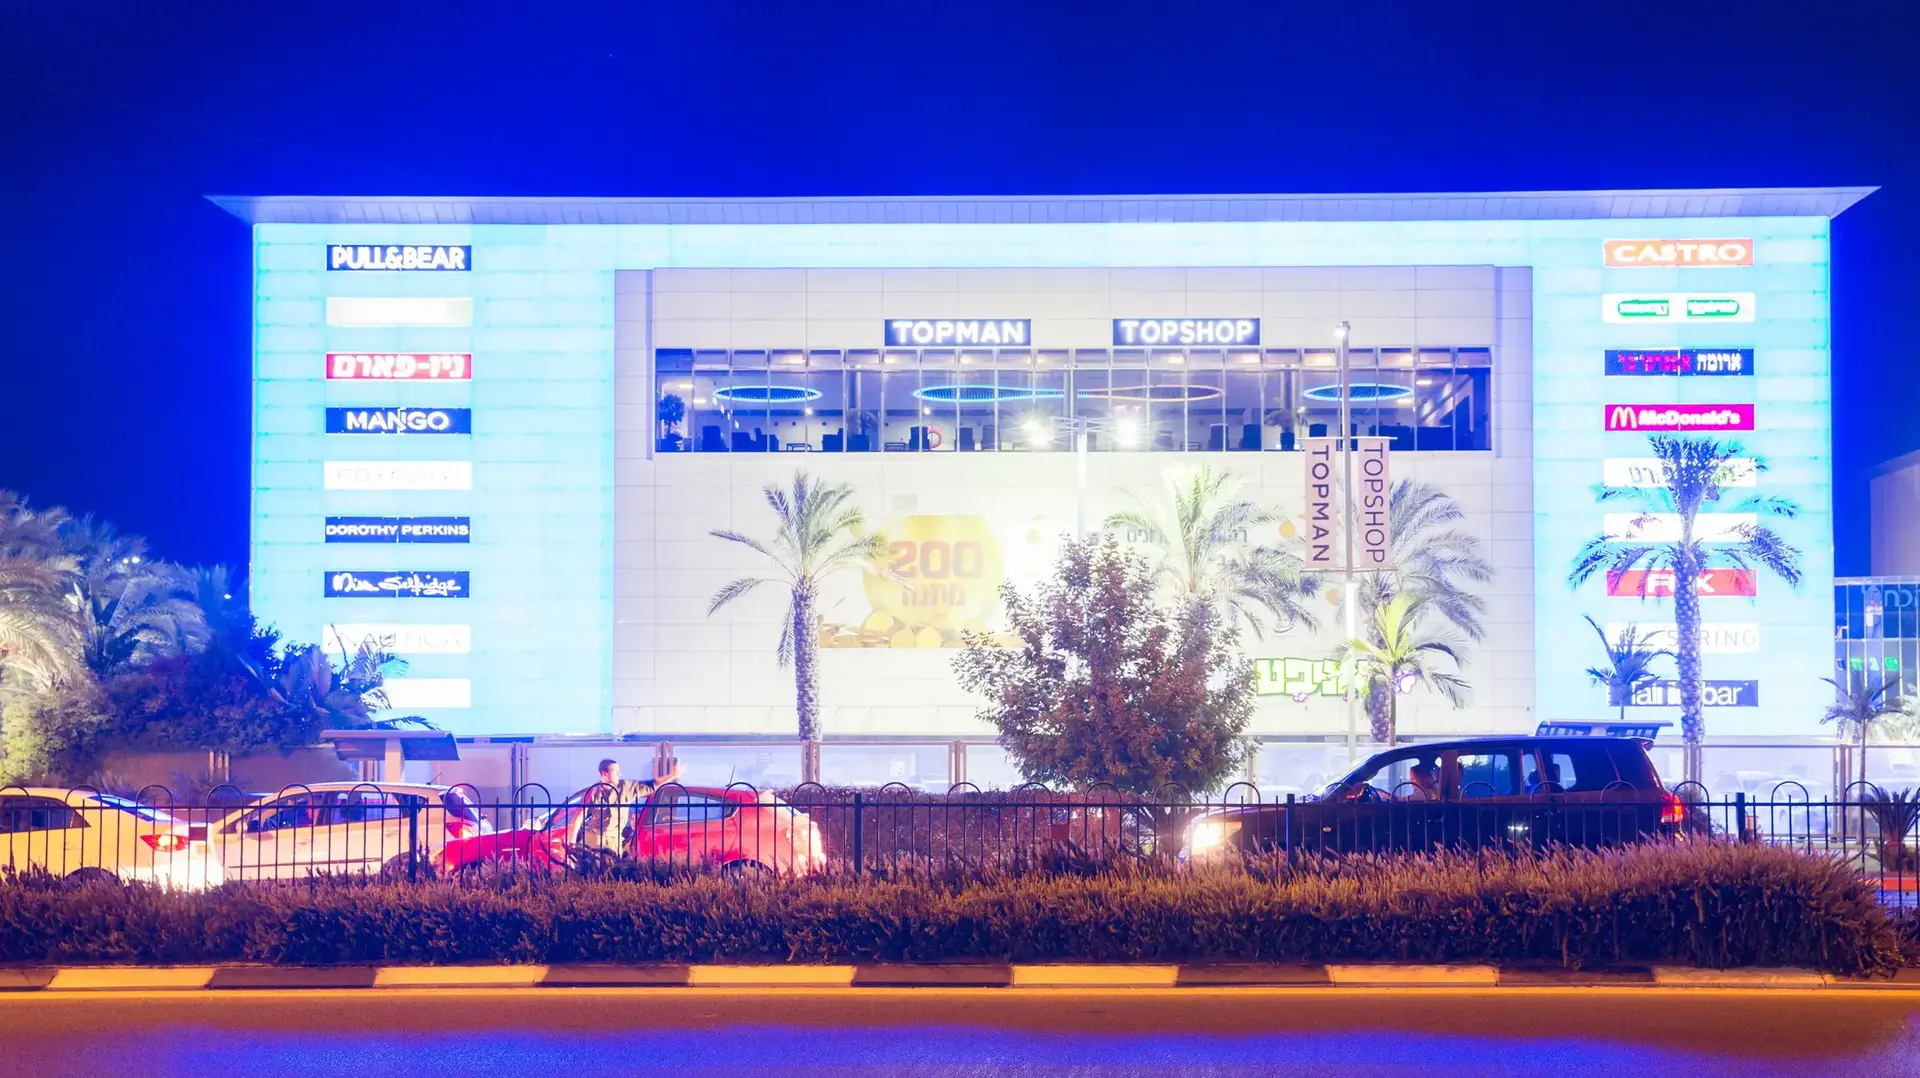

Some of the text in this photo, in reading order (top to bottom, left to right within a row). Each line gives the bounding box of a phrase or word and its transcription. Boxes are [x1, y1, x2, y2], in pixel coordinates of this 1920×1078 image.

[332, 246, 465, 270] PULL&BEAR
[1614, 245, 1746, 261] CASTRO
[892, 321, 1024, 344] TOPMAN
[1121, 320, 1255, 343] TOPSHOP
[1696, 353, 1742, 371] ארומה
[347, 412, 450, 431] MANGO
[1639, 410, 1740, 425] McDonald's
[1311, 445, 1330, 562] TOPMAN
[1363, 442, 1385, 563] TOPSHOP
[326, 524, 469, 536] DOROTHY PERKINS
[889, 540, 983, 578] 200
[1668, 630, 1756, 647] SRING
